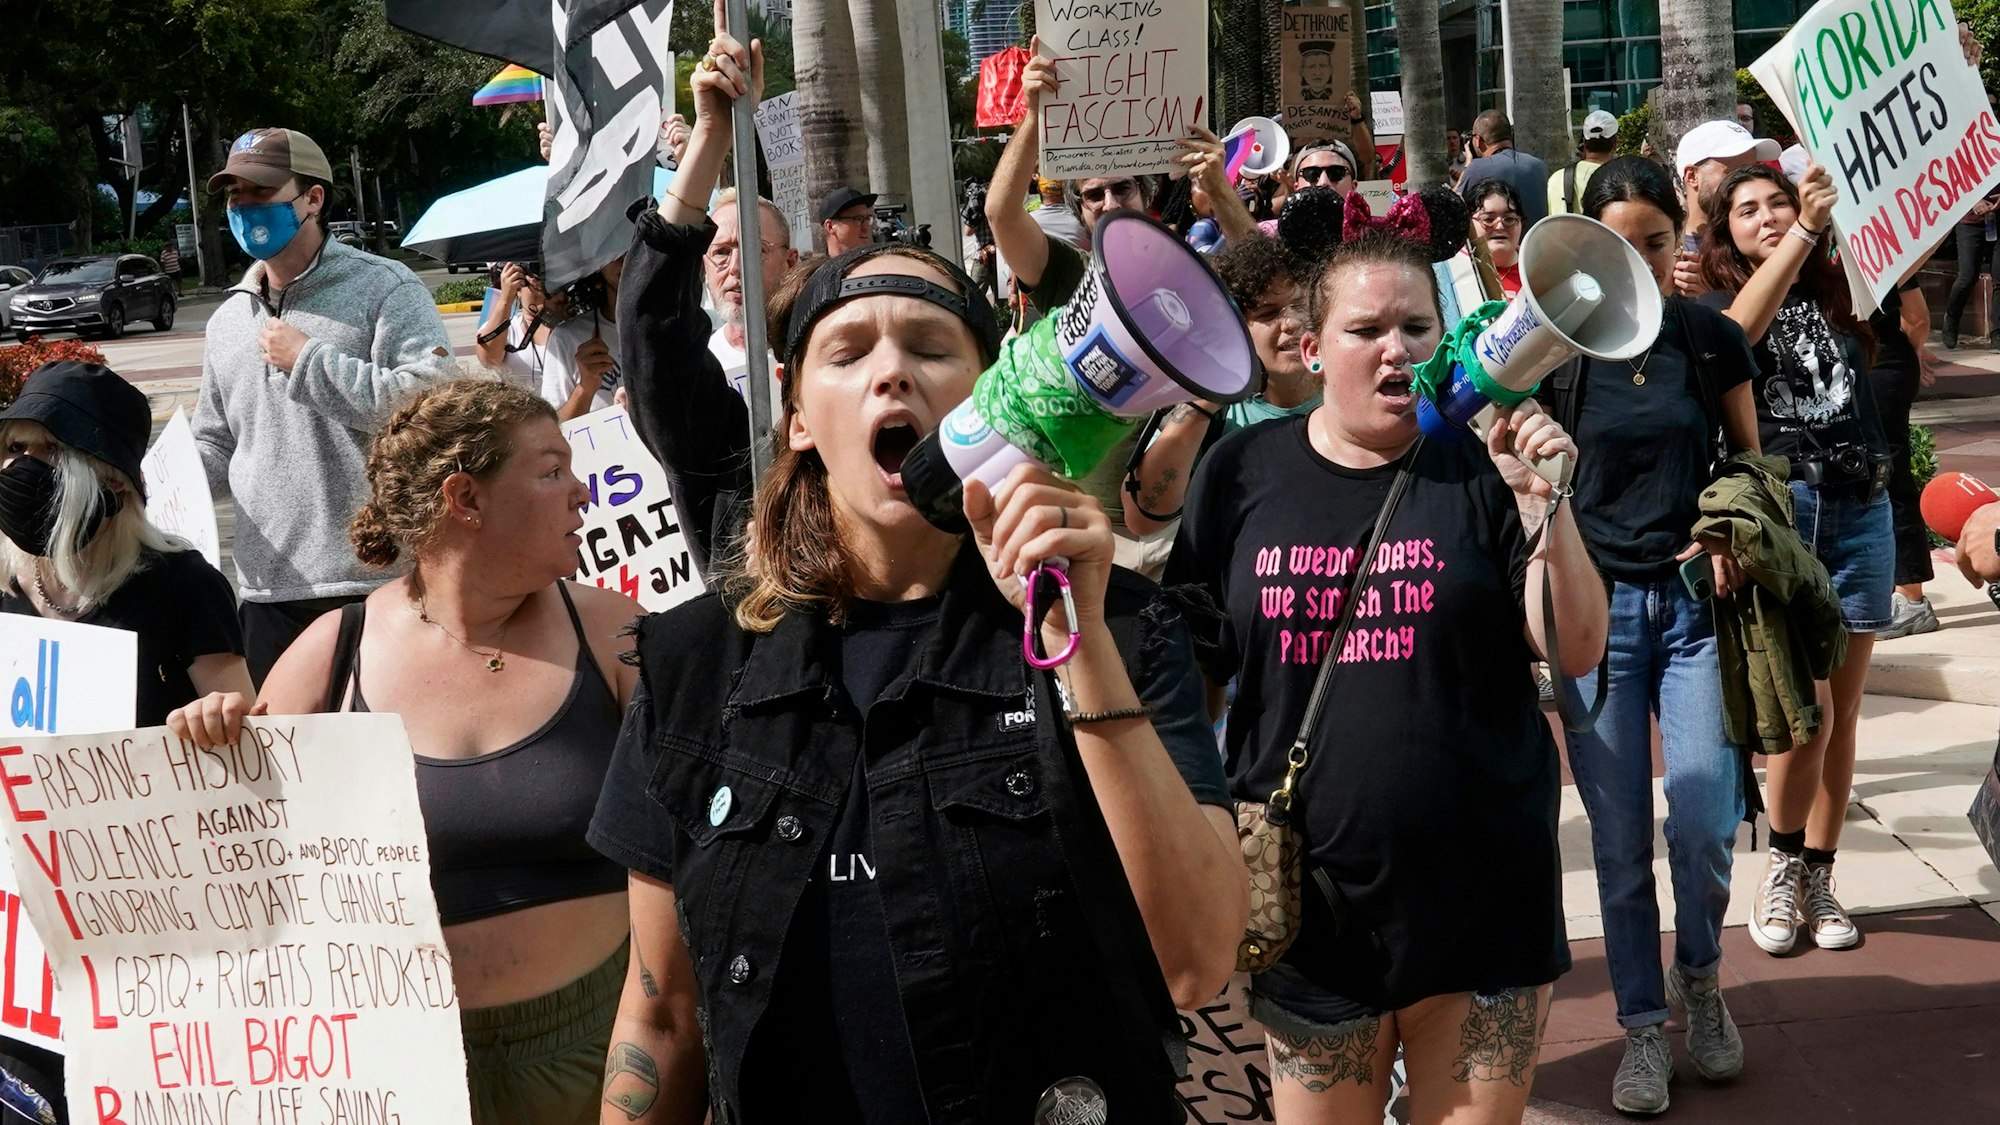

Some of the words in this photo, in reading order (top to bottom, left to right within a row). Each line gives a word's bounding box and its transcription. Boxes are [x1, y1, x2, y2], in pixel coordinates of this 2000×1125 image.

[1049, 0, 1162, 21] WORKING
[1067, 23, 1144, 51] CLASS!
[1284, 12, 1348, 32] DETHRONE
[1053, 49, 1177, 99] FIGHT
[1794, 0, 1946, 148] FLORIDA
[770, 123, 793, 142] NOT
[1044, 95, 1203, 143] FASCISM!
[1833, 62, 1948, 205] HATES
[1850, 205, 1904, 285] RON
[11, 638, 60, 734] all
[1004, 708, 1036, 726] FOR
[0, 738, 151, 822] ERASING
[162, 726, 303, 792] HISTORY
[23, 813, 193, 888] VIOLENCE
[197, 798, 289, 840] AGAINST
[203, 837, 294, 876] LGBTQ+
[300, 842, 321, 860] AND
[320, 836, 375, 867] BIPOC
[376, 844, 422, 864] PEOPLE
[54, 884, 199, 940] IGNORING
[204, 872, 316, 932] CLIMATE
[320, 871, 415, 928] CHANGE
[216, 942, 313, 1009] RIGHTS
[326, 941, 457, 1013] REVOKED
[150, 1020, 234, 1089] EVIL
[245, 1013, 358, 1086] BIGOT
